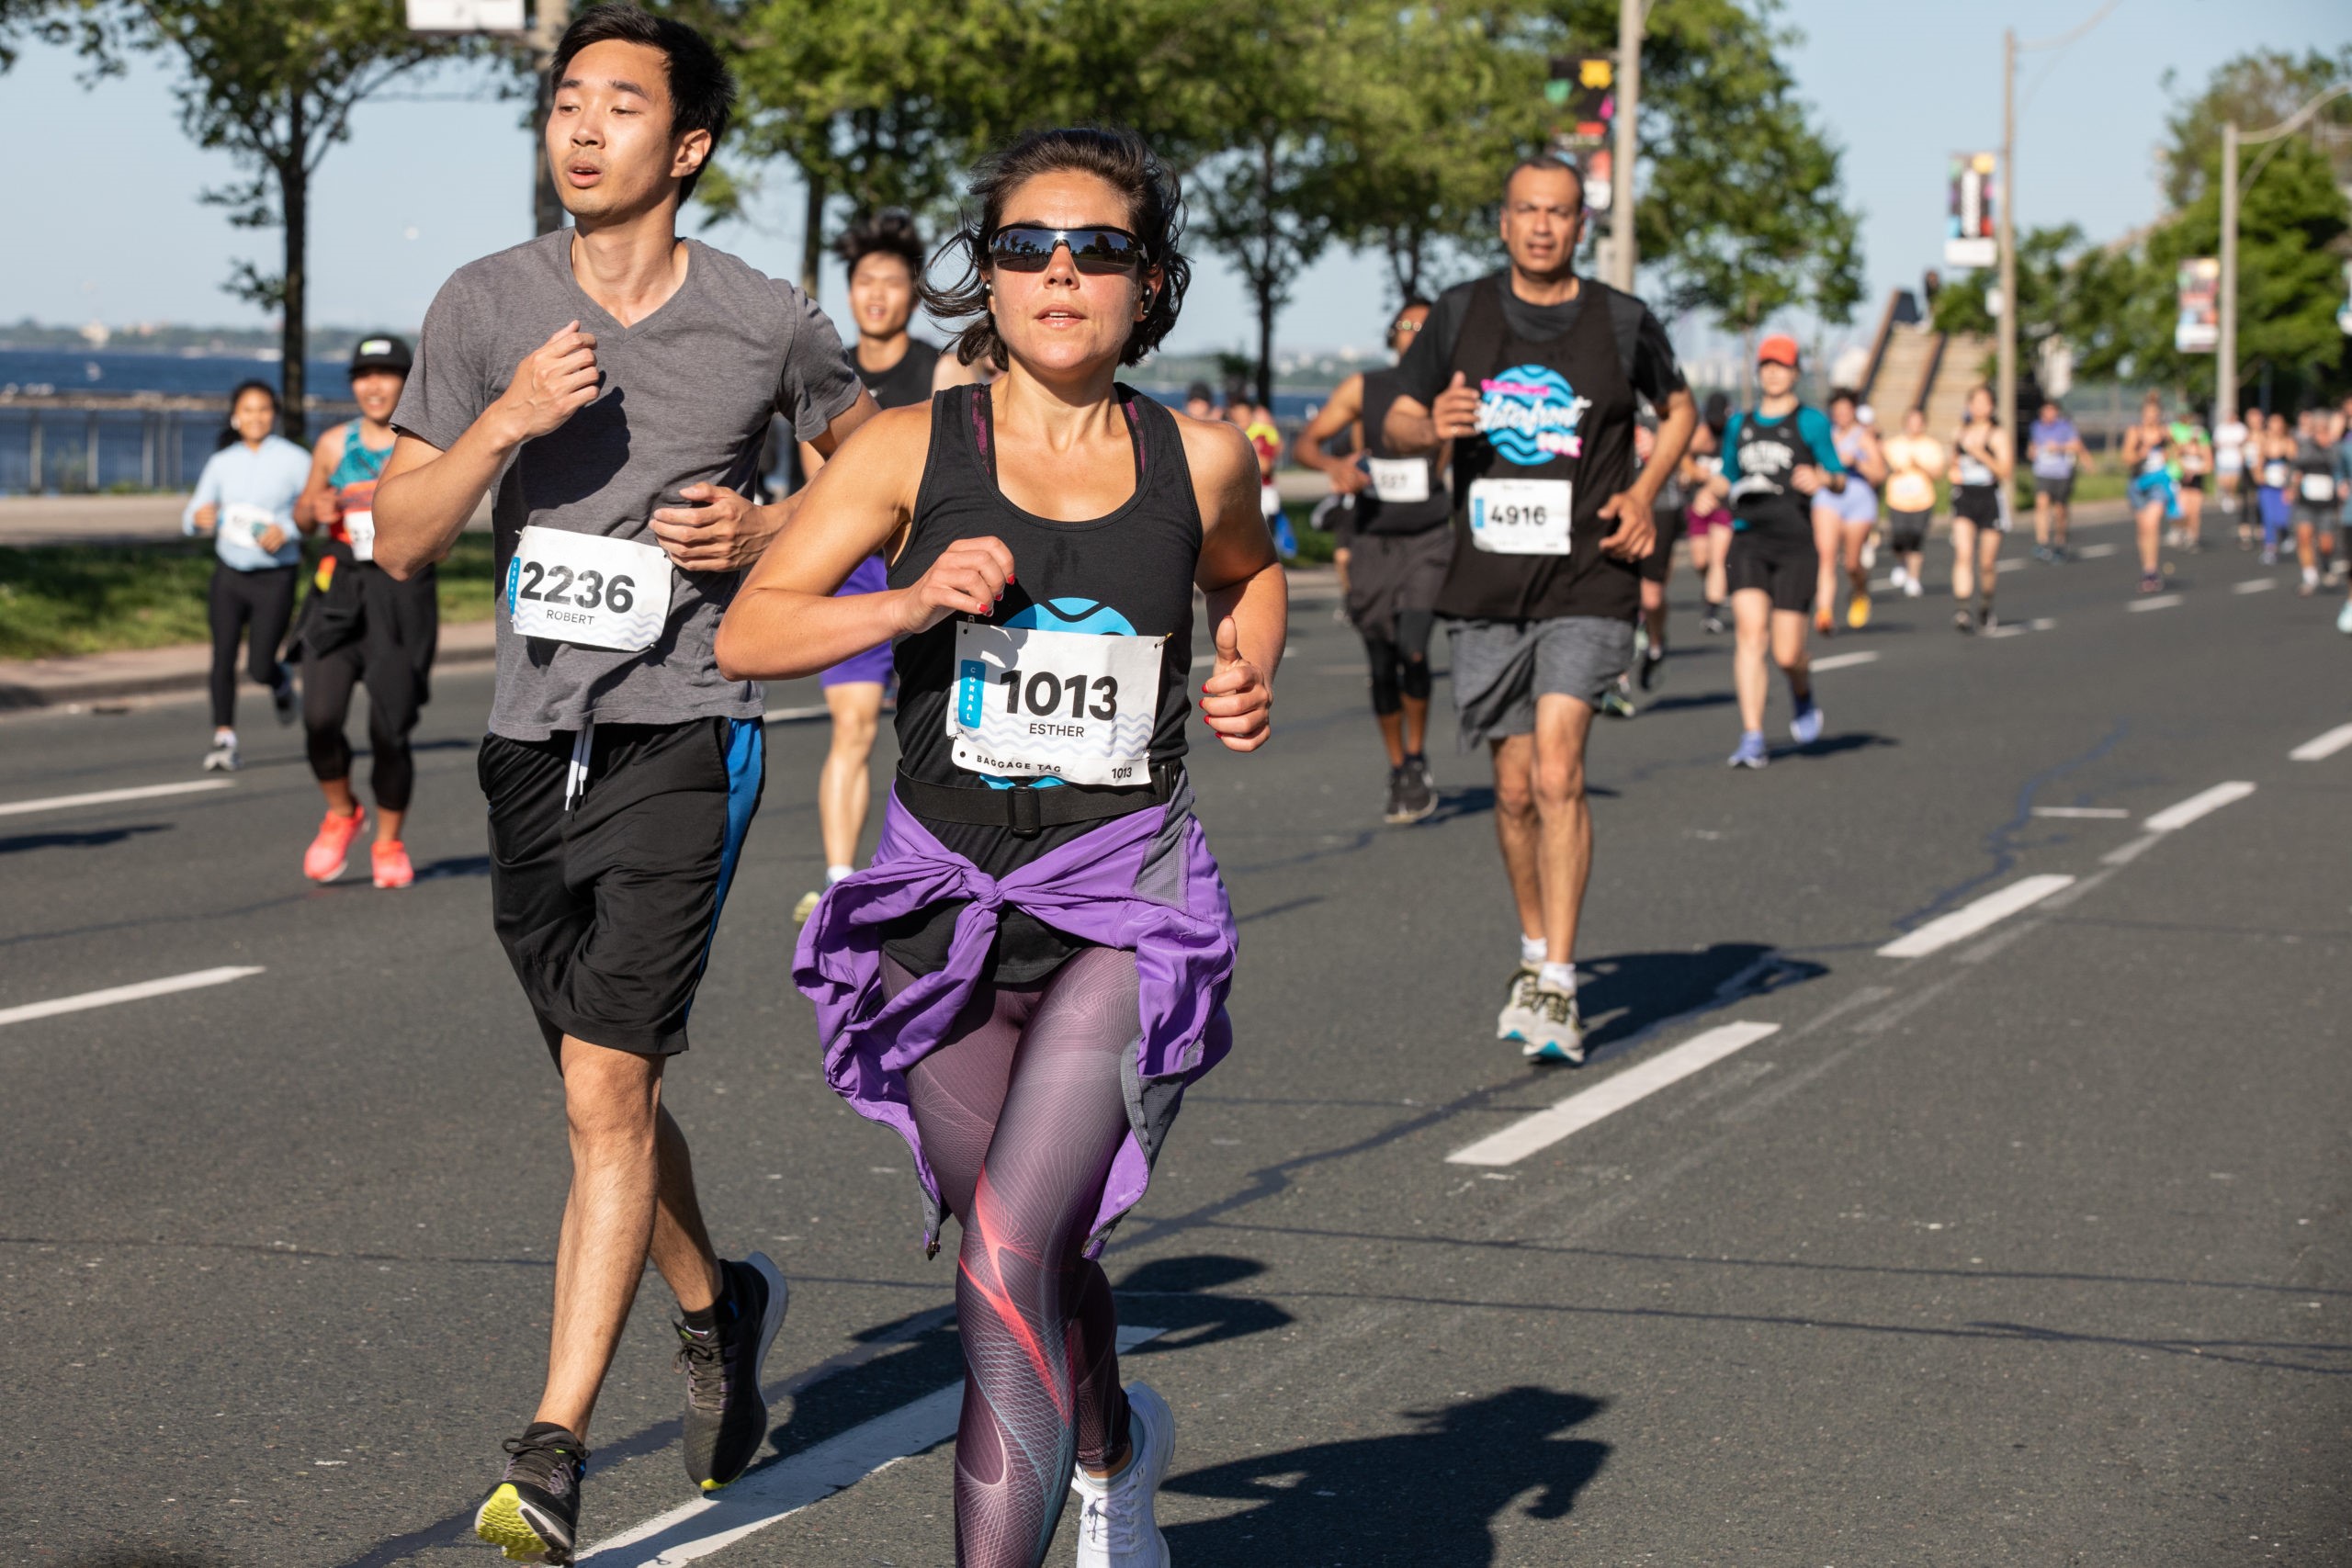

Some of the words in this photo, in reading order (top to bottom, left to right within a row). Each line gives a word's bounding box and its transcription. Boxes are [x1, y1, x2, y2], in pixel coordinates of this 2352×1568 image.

[1491, 506, 1546, 525] 4916
[520, 561, 635, 613] 2236
[547, 610, 594, 625] ROBERT
[966, 667, 976, 720] CORRAL
[1001, 671, 1118, 720] 1013
[1029, 724, 1084, 738] ESTHER
[977, 755, 1031, 770] BAGGAGE
[1037, 764, 1061, 773] TAG
[1111, 767, 1133, 779] 1013
